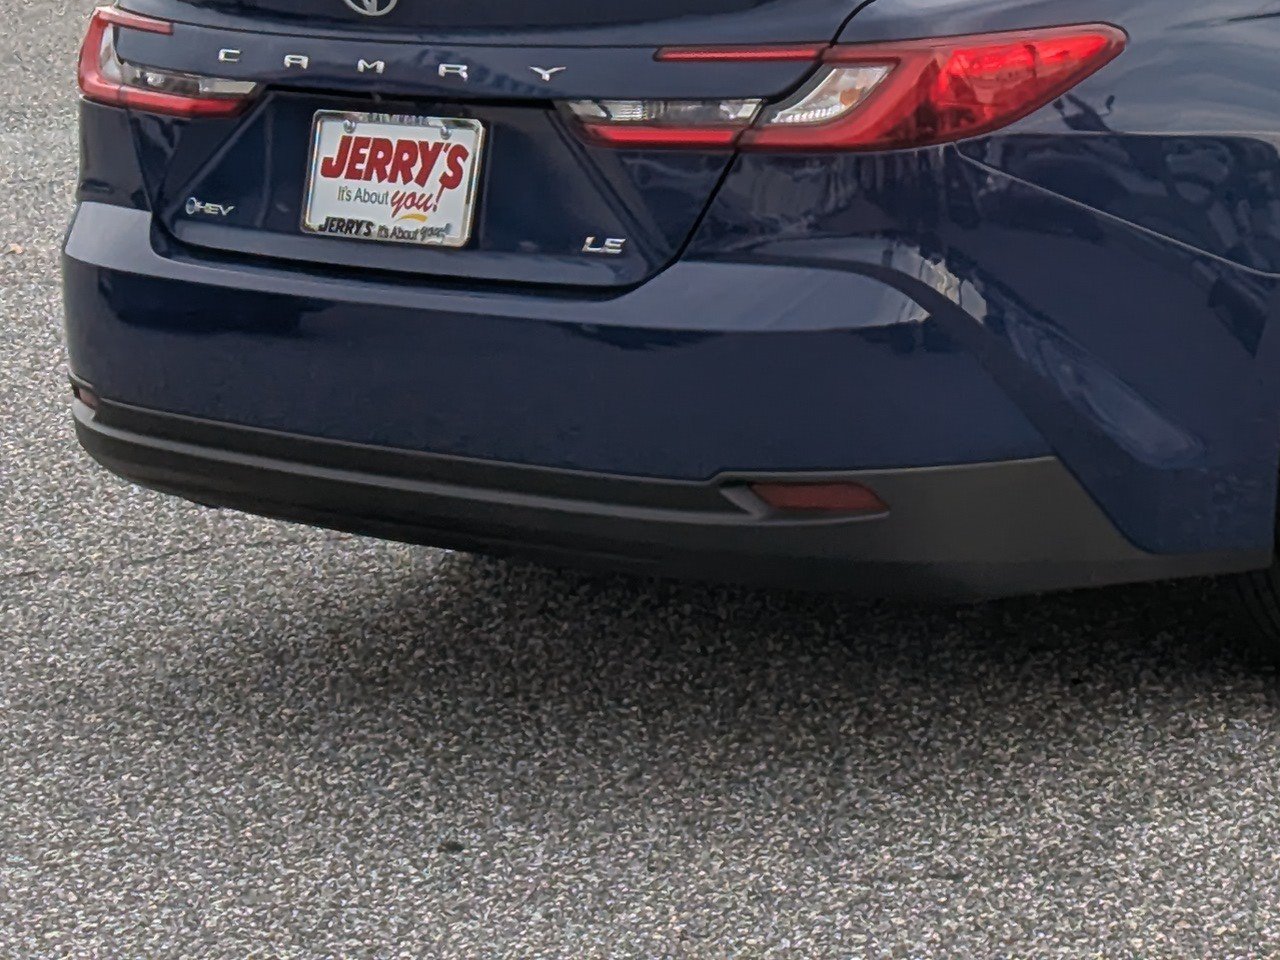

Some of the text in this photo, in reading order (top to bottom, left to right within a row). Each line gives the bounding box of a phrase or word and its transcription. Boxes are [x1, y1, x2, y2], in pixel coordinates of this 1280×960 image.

[218, 47, 566, 83] CAMRY
[320, 134, 469, 191] JERRY'S
[195, 201, 236, 217] HEV
[337, 186, 445, 219] It's About you!
[582, 236, 626, 255] LE
